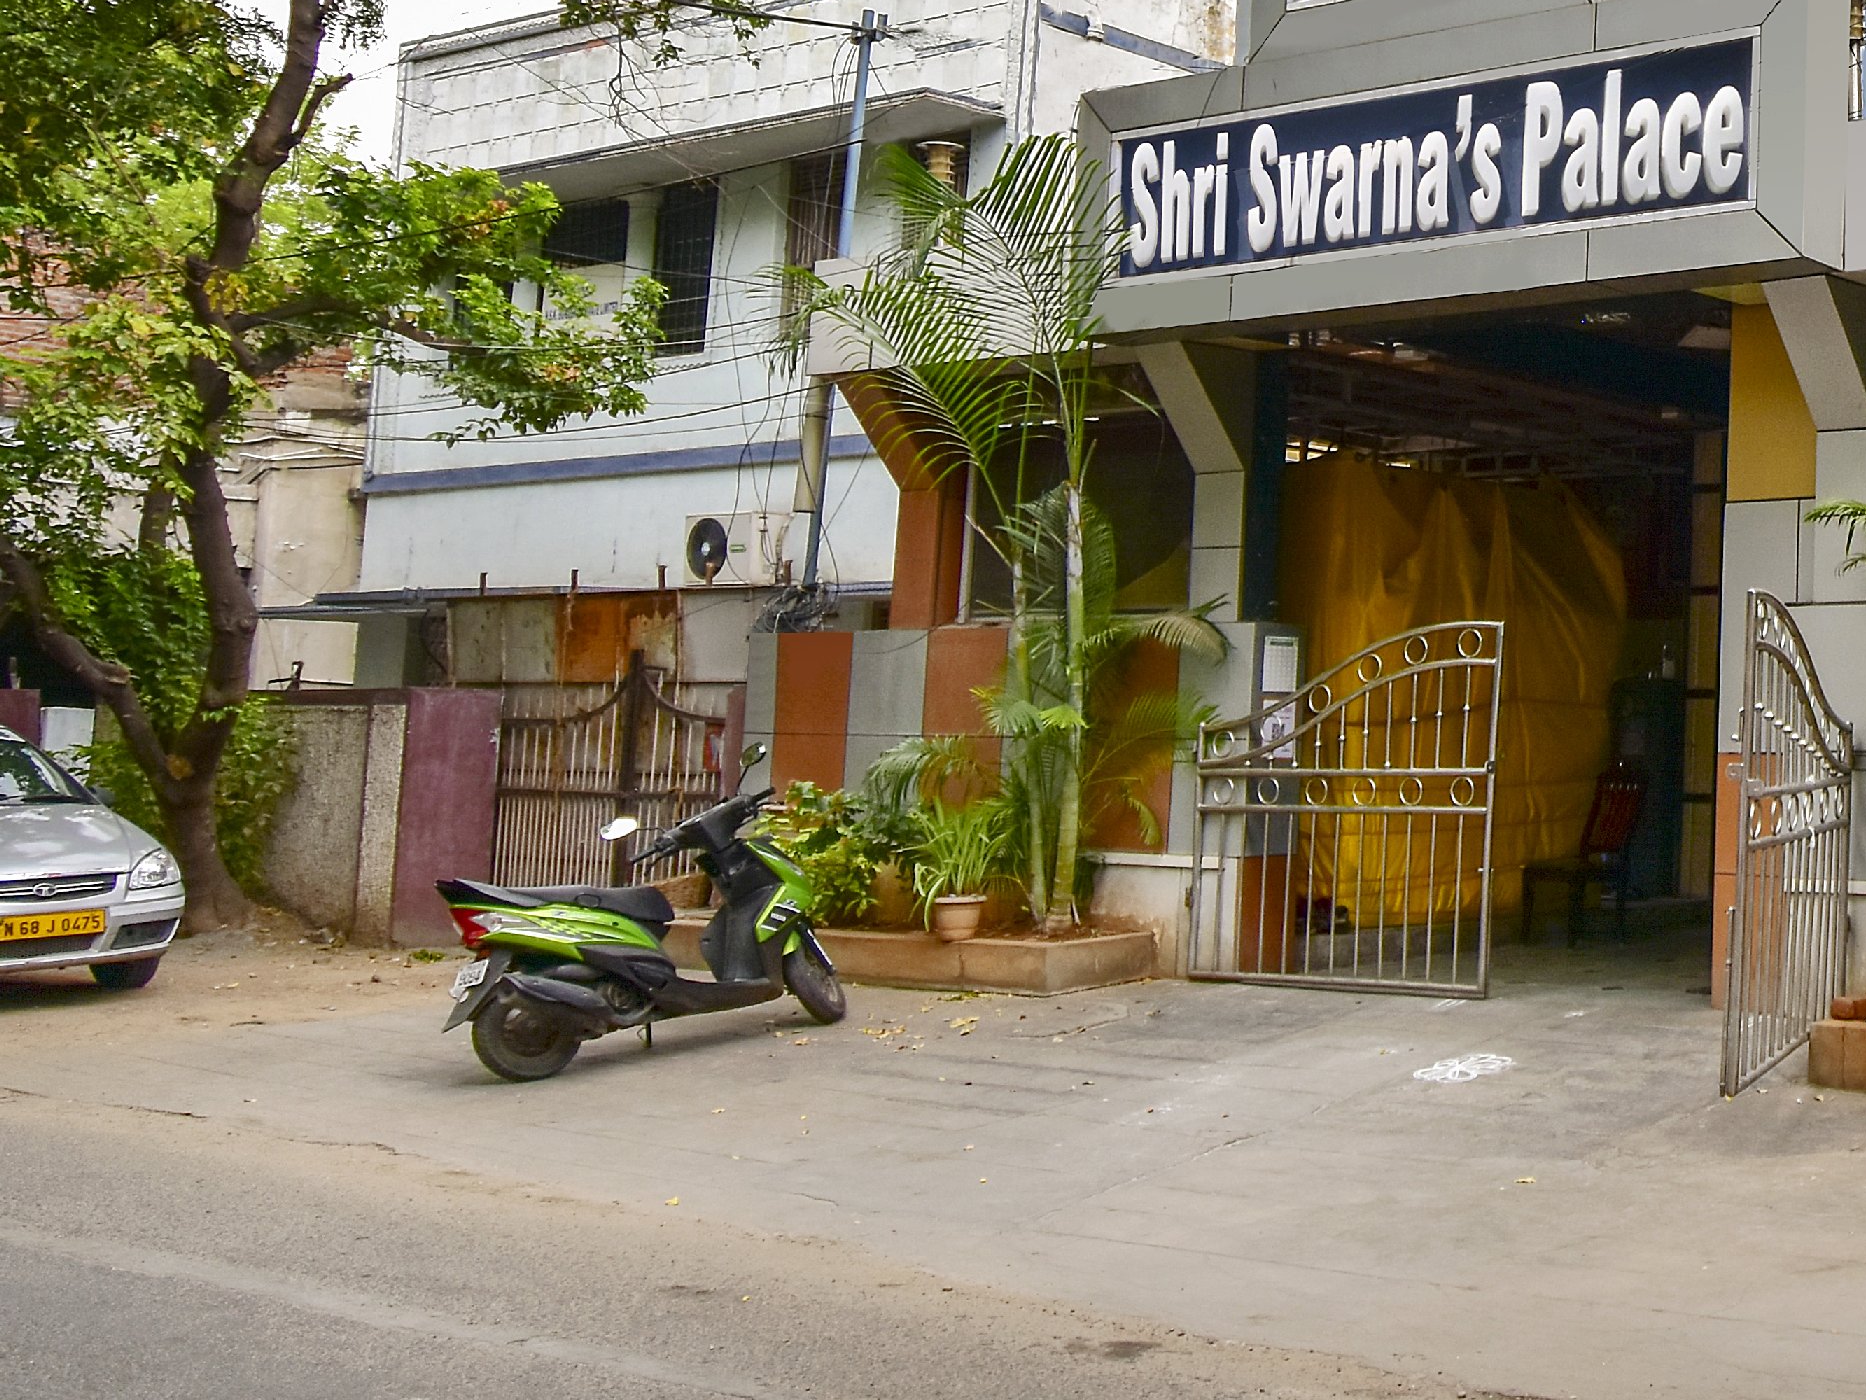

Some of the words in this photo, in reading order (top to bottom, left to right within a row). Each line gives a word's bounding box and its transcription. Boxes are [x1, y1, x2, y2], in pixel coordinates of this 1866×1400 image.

[1130, 132, 1229, 268] Shri
[1247, 94, 1502, 253] Swarna's
[1520, 69, 1744, 218] Palace
[0, 920, 14, 937] N
[20, 920, 40, 935] 68
[46, 919, 55, 933] J
[61, 915, 100, 931] 0475
